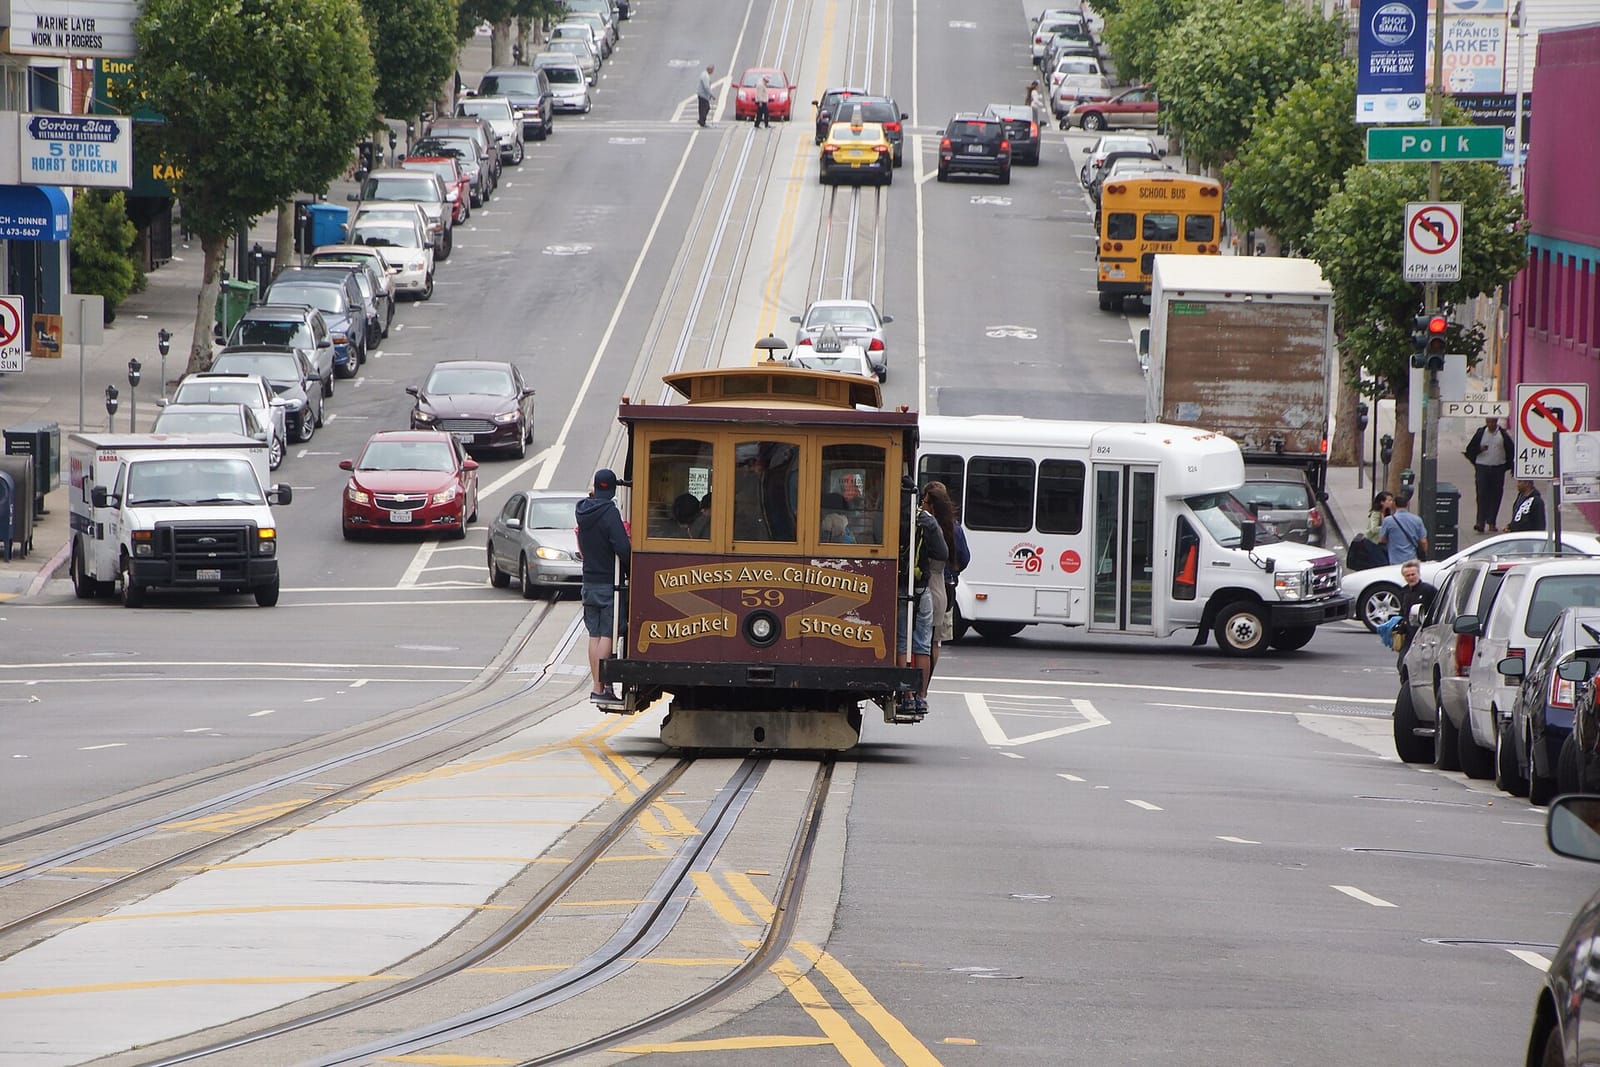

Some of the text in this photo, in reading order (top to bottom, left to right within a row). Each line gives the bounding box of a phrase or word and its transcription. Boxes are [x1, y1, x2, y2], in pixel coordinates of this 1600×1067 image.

[37, 15, 96, 32] MARINE LAYER
[1382, 16, 1407, 25] SHOP
[1453, 17, 1475, 27] New
[1379, 24, 1408, 32] SMALL
[1449, 27, 1499, 38] FRANCIS
[31, 32, 103, 49] WORK IN PROGRESS
[1371, 57, 1414, 65] EVERY DAY
[1370, 64, 1414, 73] BY THE BAY
[38, 118, 80, 131] Cordon
[49, 142, 101, 158] 5 SPICE
[1401, 135, 1470, 153] Polk
[31, 157, 118, 174] ROAST CHICKEN
[1139, 187, 1186, 199] SCHOOL BUS
[18, 216, 47, 226] DINNER
[1408, 263, 1428, 272] 4PM
[1437, 263, 1458, 272] 6PM
[1, 347, 21, 359] 6PM
[1, 360, 18, 369] SUN
[1449, 404, 1502, 415] POLK
[1097, 446, 1111, 454] 824
[1519, 447, 1546, 462] 4PM
[658, 572, 689, 588] Van
[688, 567, 733, 584] Ness
[782, 567, 870, 594] California
[740, 589, 785, 608] 59
[649, 616, 729, 638] & Market
[800, 617, 873, 641] Streets
